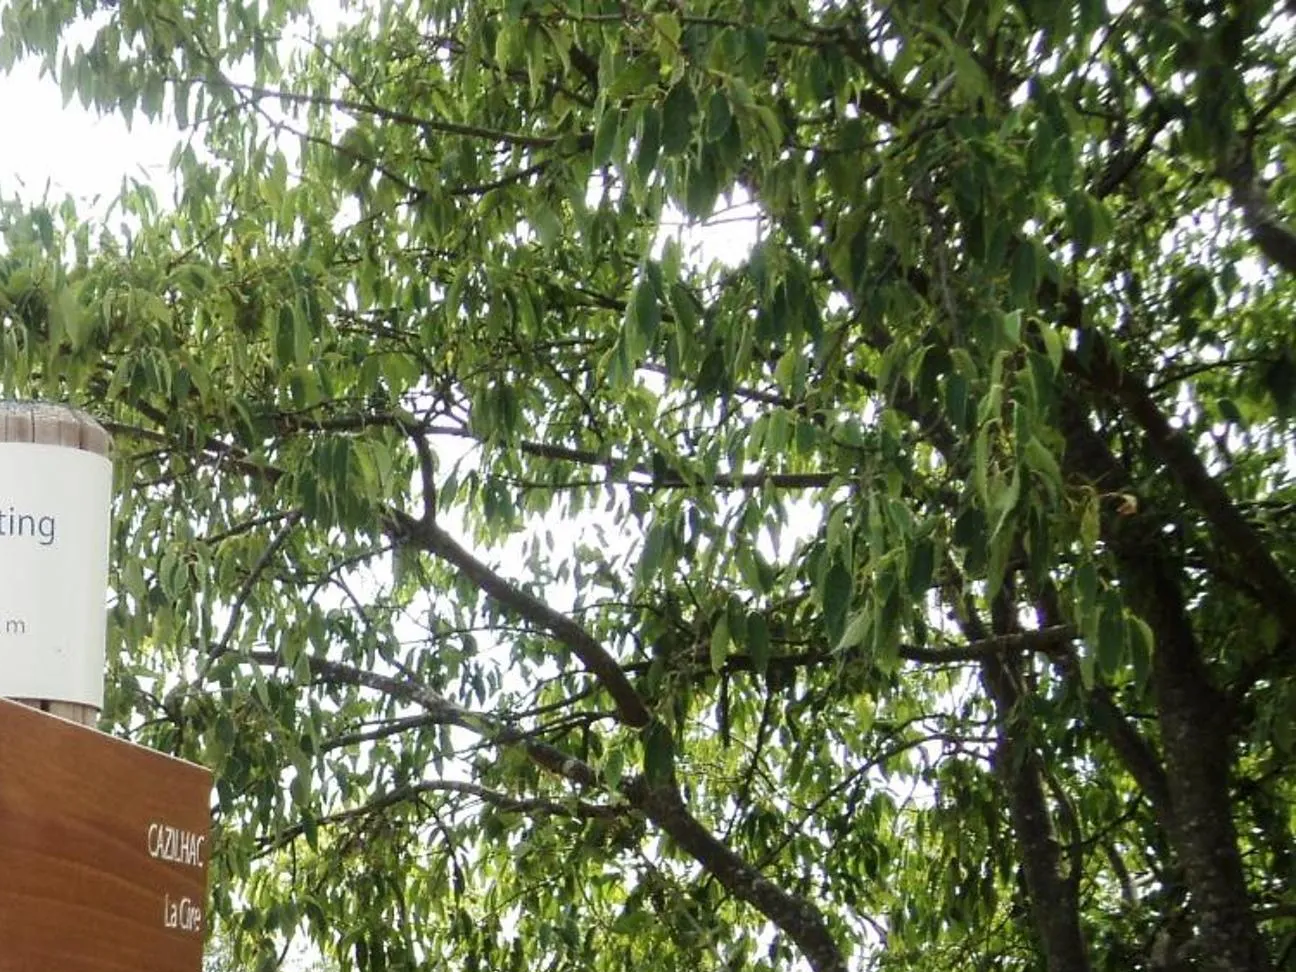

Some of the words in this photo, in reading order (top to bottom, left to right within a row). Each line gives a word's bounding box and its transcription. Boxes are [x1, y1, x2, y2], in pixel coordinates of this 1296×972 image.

[6, 618, 25, 633] m
[147, 823, 205, 867] CAZILHAC
[164, 893, 177, 928] La
